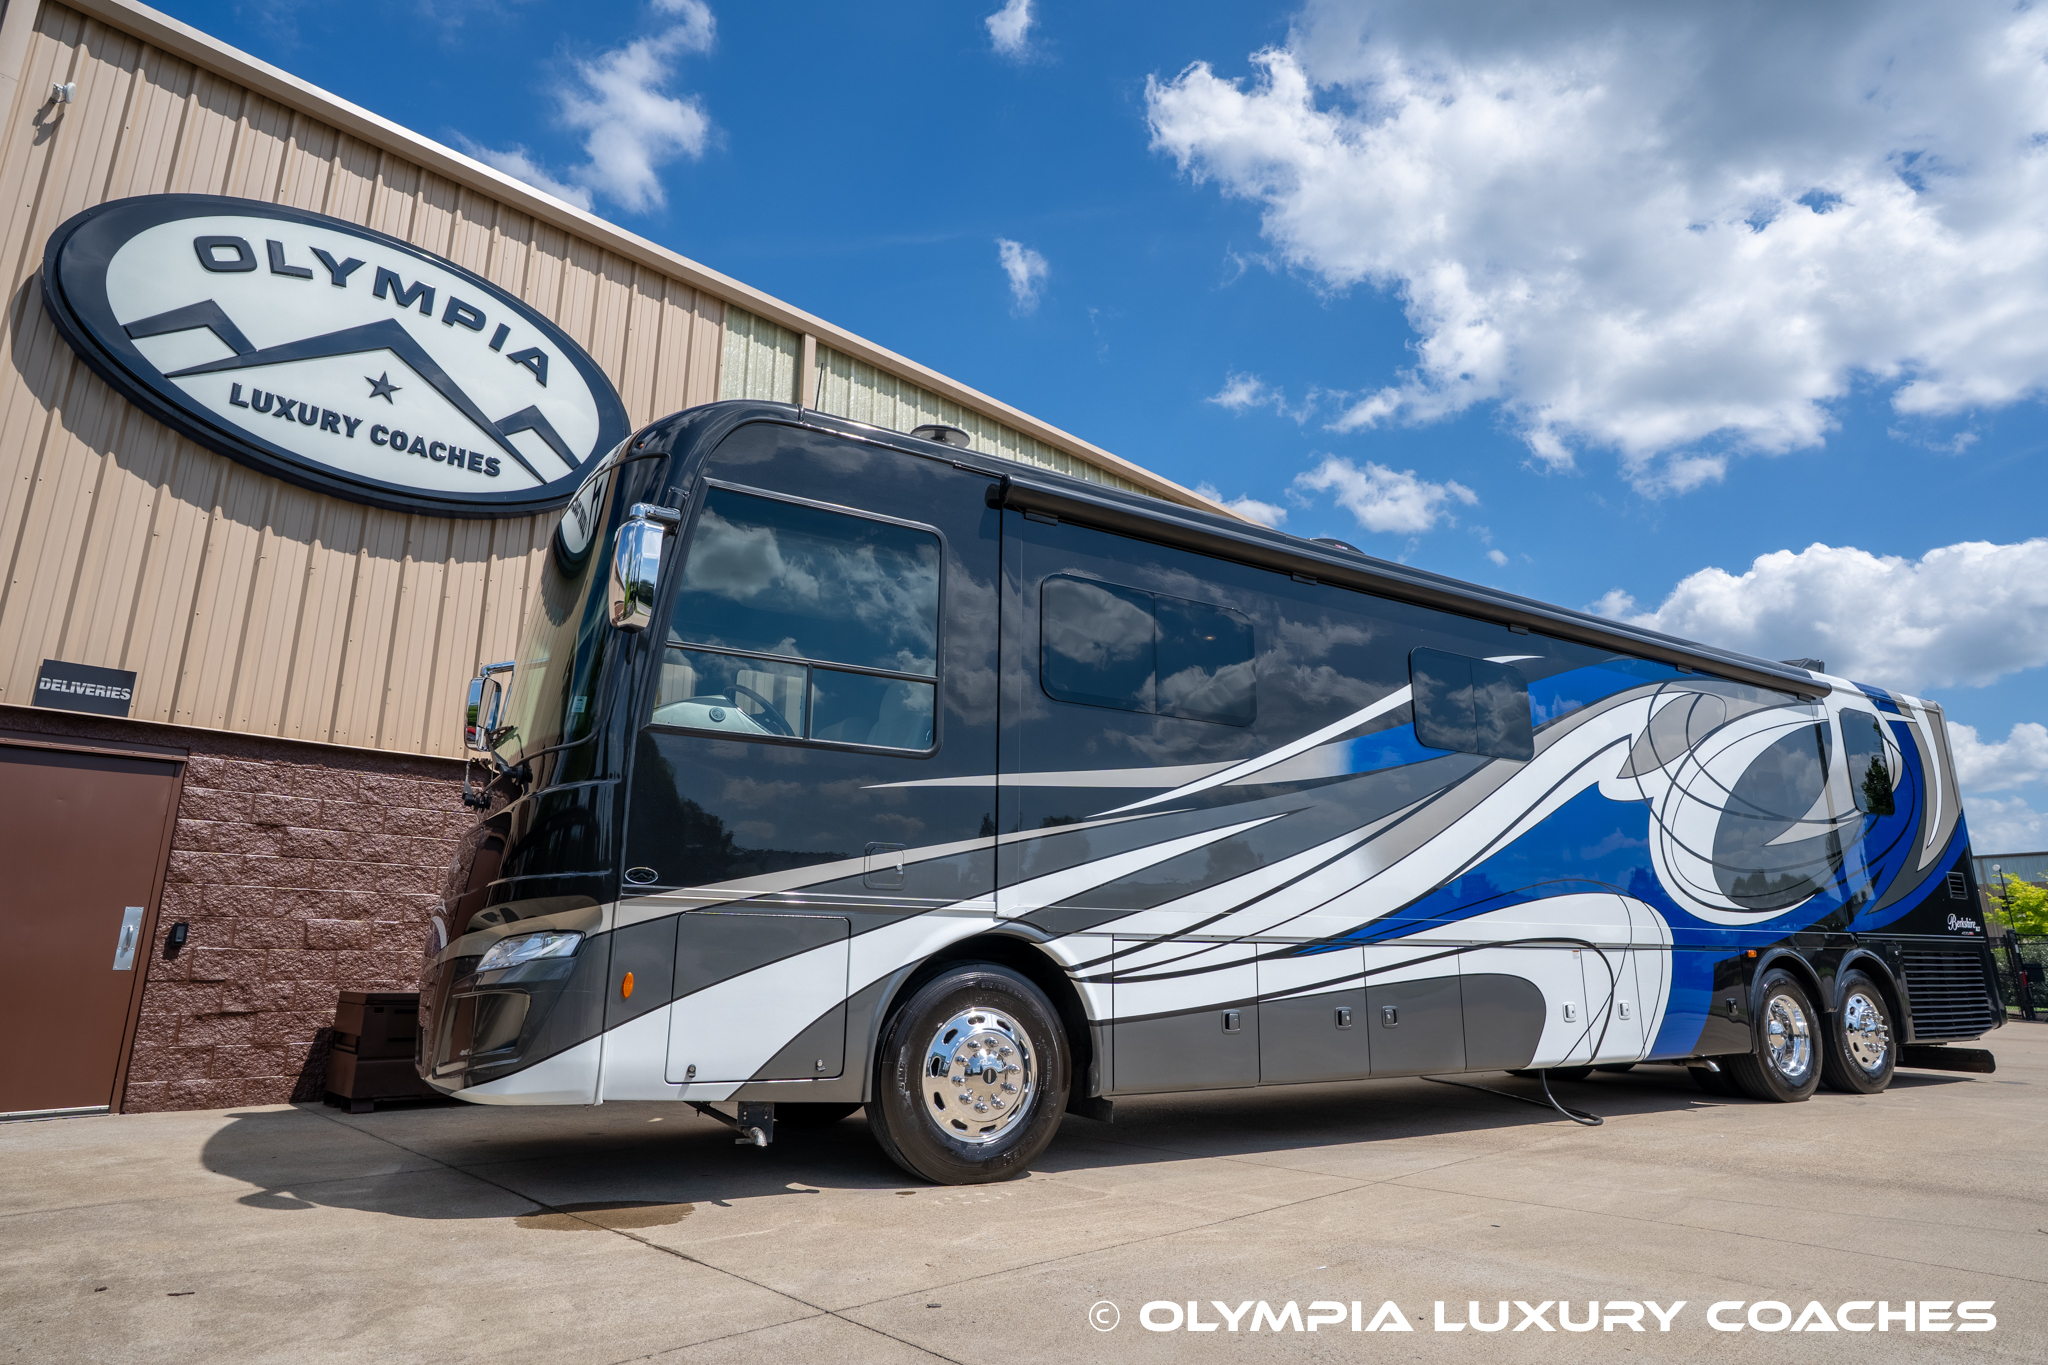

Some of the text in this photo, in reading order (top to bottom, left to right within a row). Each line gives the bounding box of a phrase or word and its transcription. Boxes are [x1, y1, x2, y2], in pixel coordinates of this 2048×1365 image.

[193, 235, 551, 387] OLYMPIA
[229, 382, 502, 477] LUXURY COACHES
[39, 677, 131, 701] DELIVERIES
[1947, 913, 1976, 931] Berkshire
